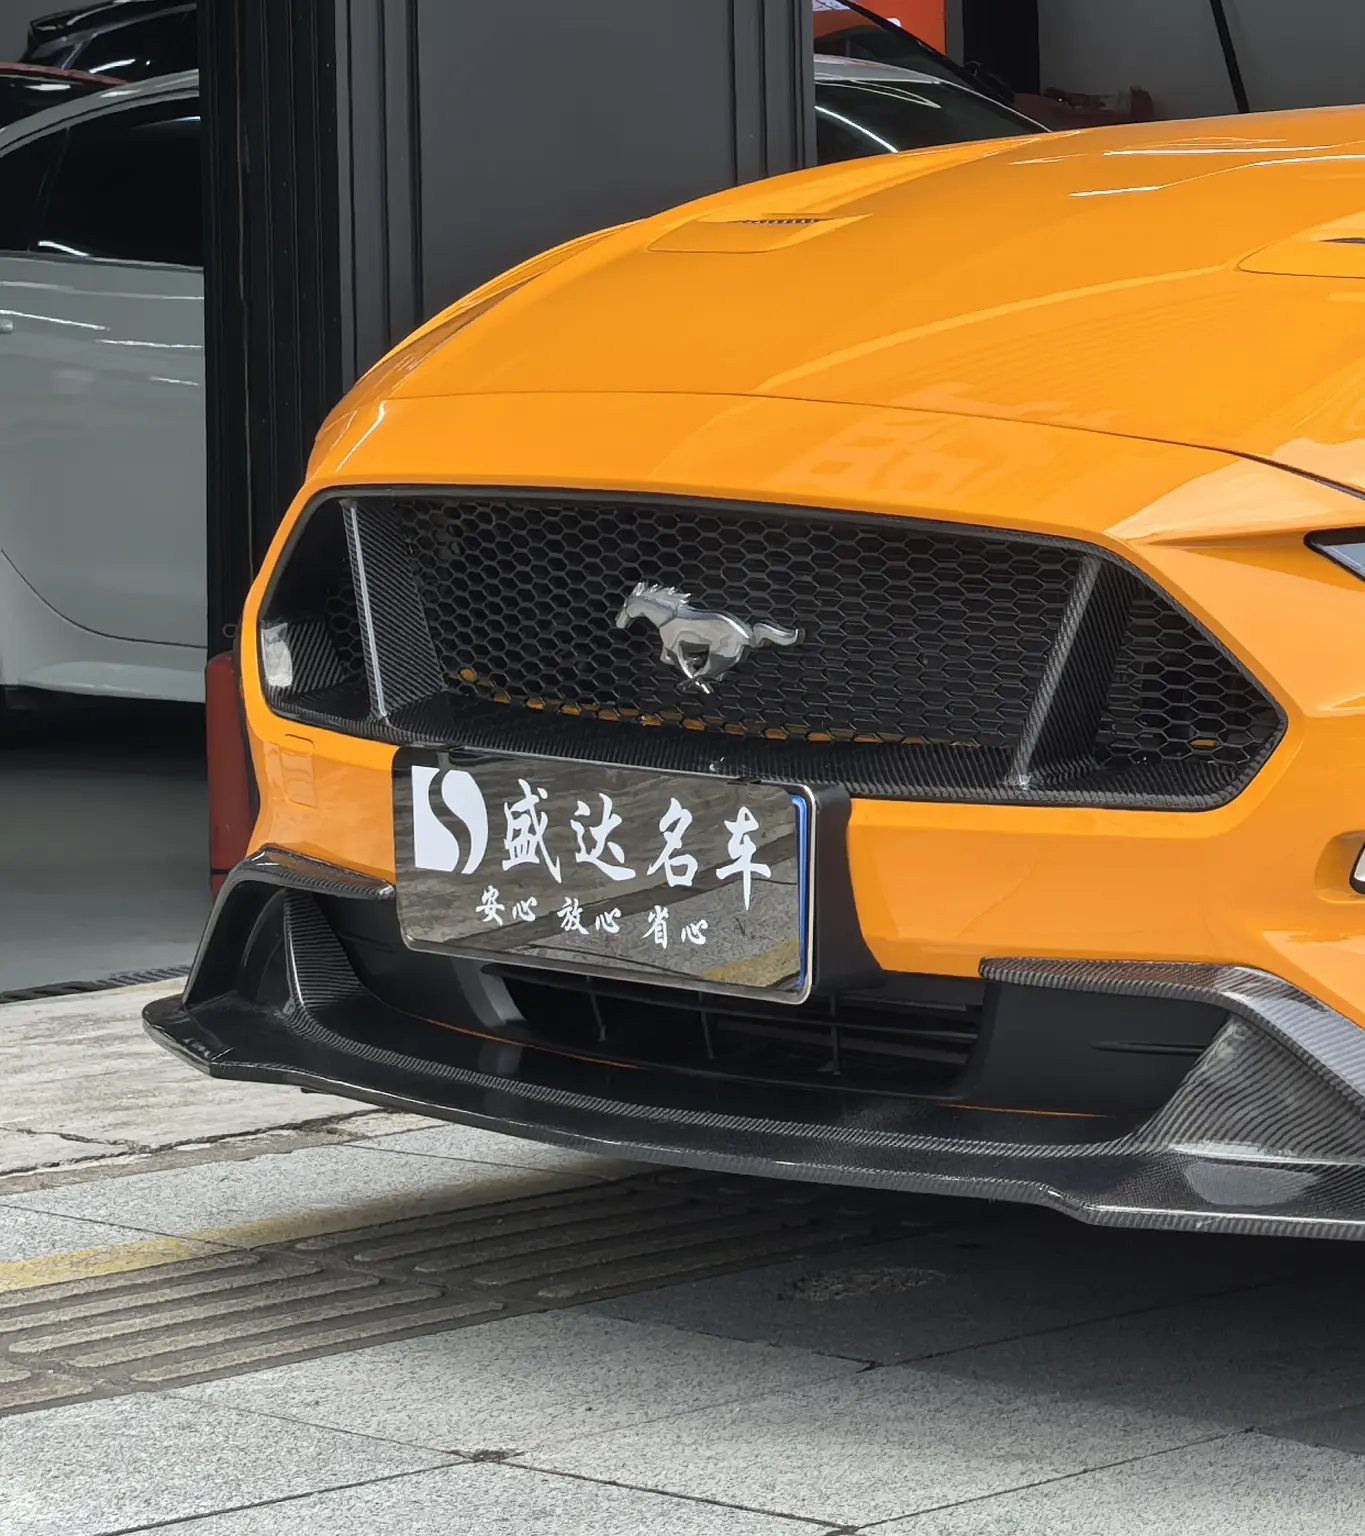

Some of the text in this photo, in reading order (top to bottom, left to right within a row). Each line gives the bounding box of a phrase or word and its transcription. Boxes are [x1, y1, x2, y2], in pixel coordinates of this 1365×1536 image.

[502, 778, 773, 911] 盛达名车
[475, 884, 710, 950] 安心 放心 省心
